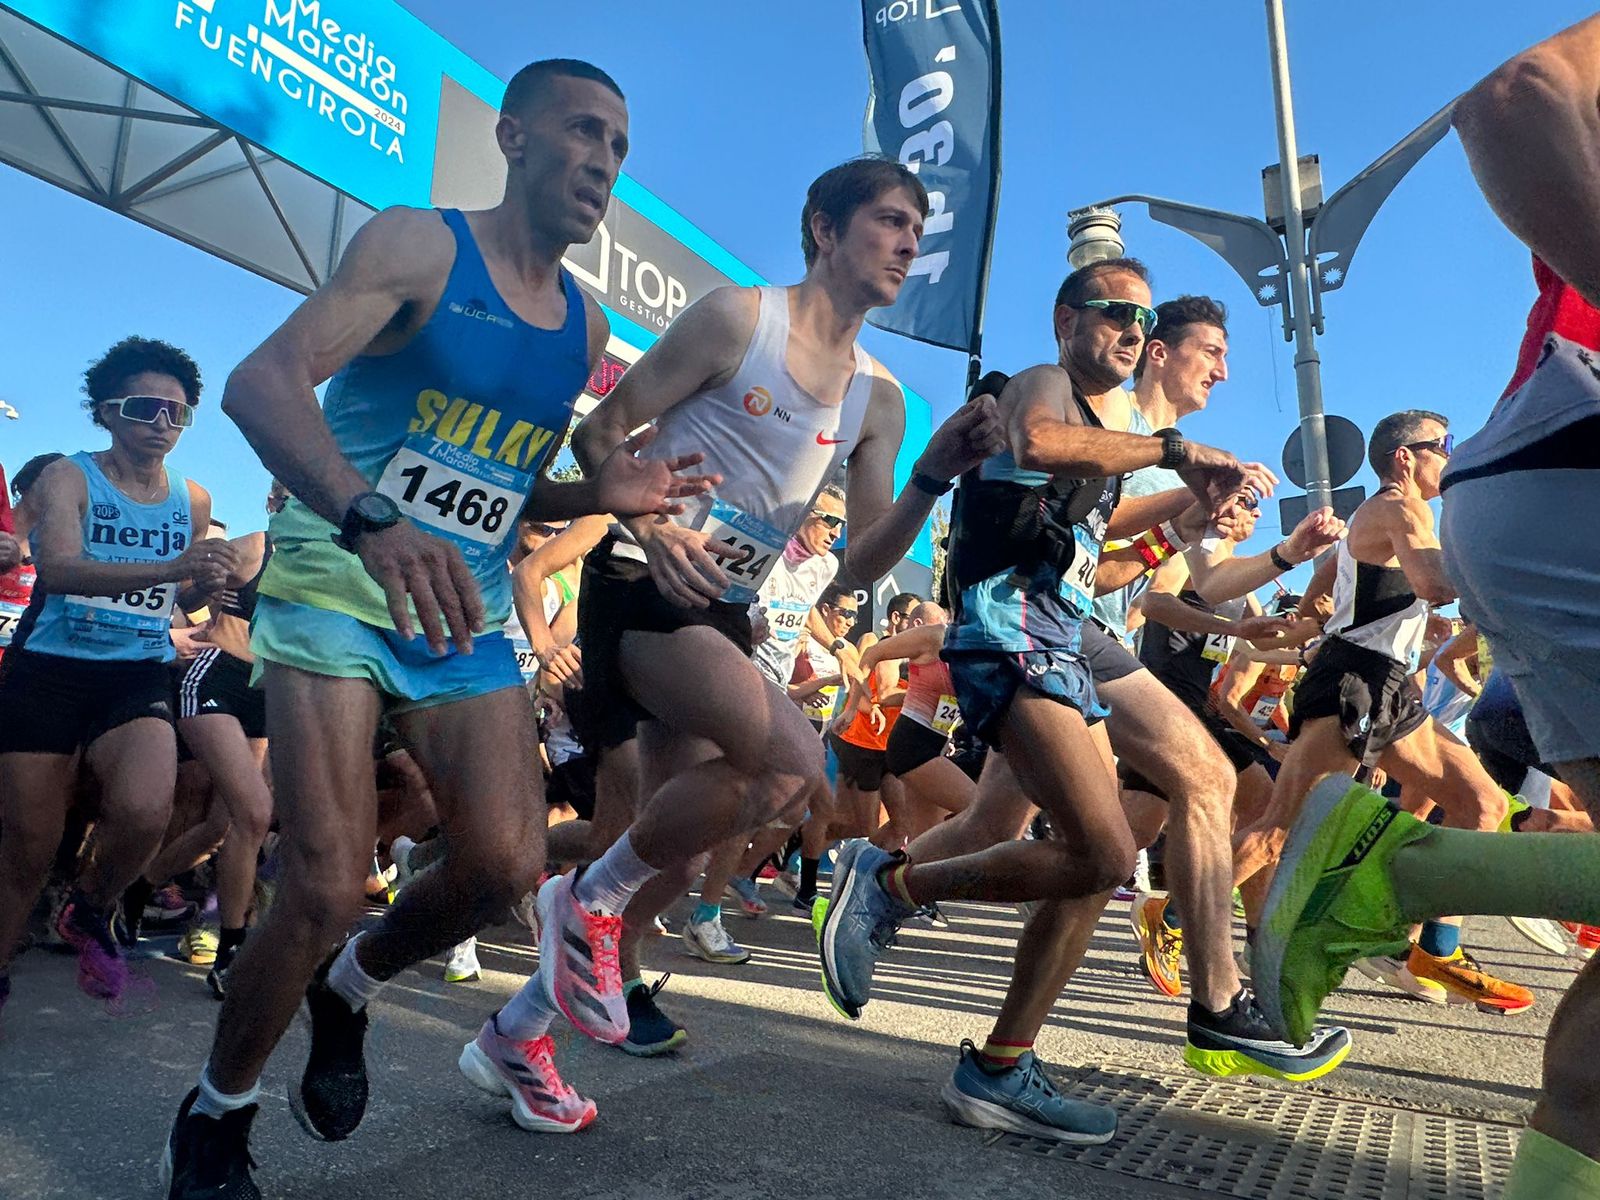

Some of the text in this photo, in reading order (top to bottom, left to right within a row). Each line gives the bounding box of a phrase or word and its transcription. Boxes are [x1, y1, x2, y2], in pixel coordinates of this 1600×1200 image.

[264, 0, 408, 115] Maratón
[297, 0, 396, 82] Media
[175, 2, 405, 164] FUENGIROLA
[374, 107, 402, 131] 2024
[614, 241, 687, 319] TOP
[407, 388, 555, 470] SULAY
[428, 436, 480, 466] 7 Media
[773, 407, 791, 423] NN
[400, 464, 509, 533] 1468
[90, 521, 186, 557] nerja
